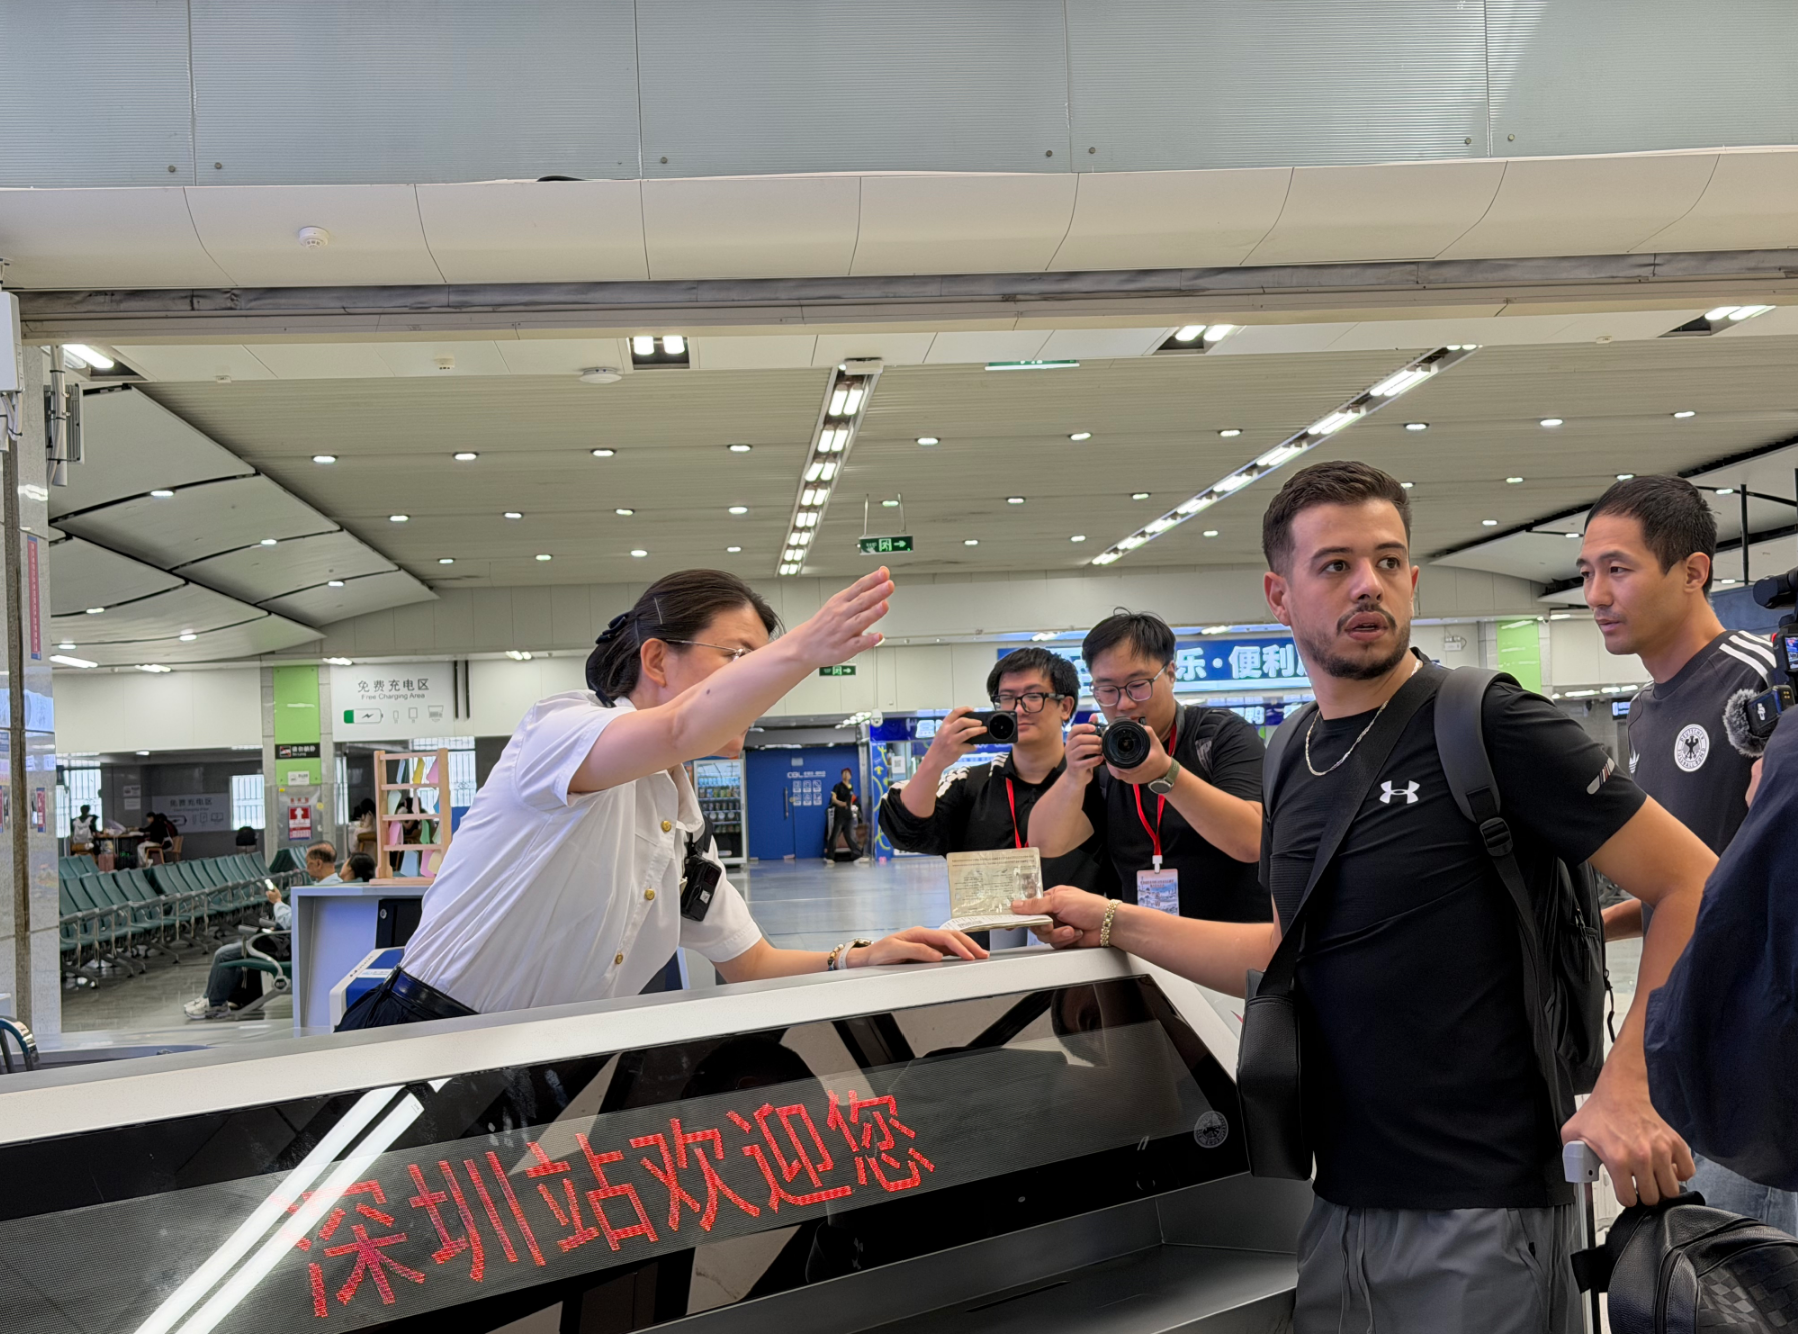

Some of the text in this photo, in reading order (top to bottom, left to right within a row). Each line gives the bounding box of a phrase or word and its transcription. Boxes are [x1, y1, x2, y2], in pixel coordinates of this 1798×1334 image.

[358, 678, 429, 693] 免费充电区
[379, 692, 408, 700] Charging
[287, 1089, 935, 1318] 深圳站欢迎您
